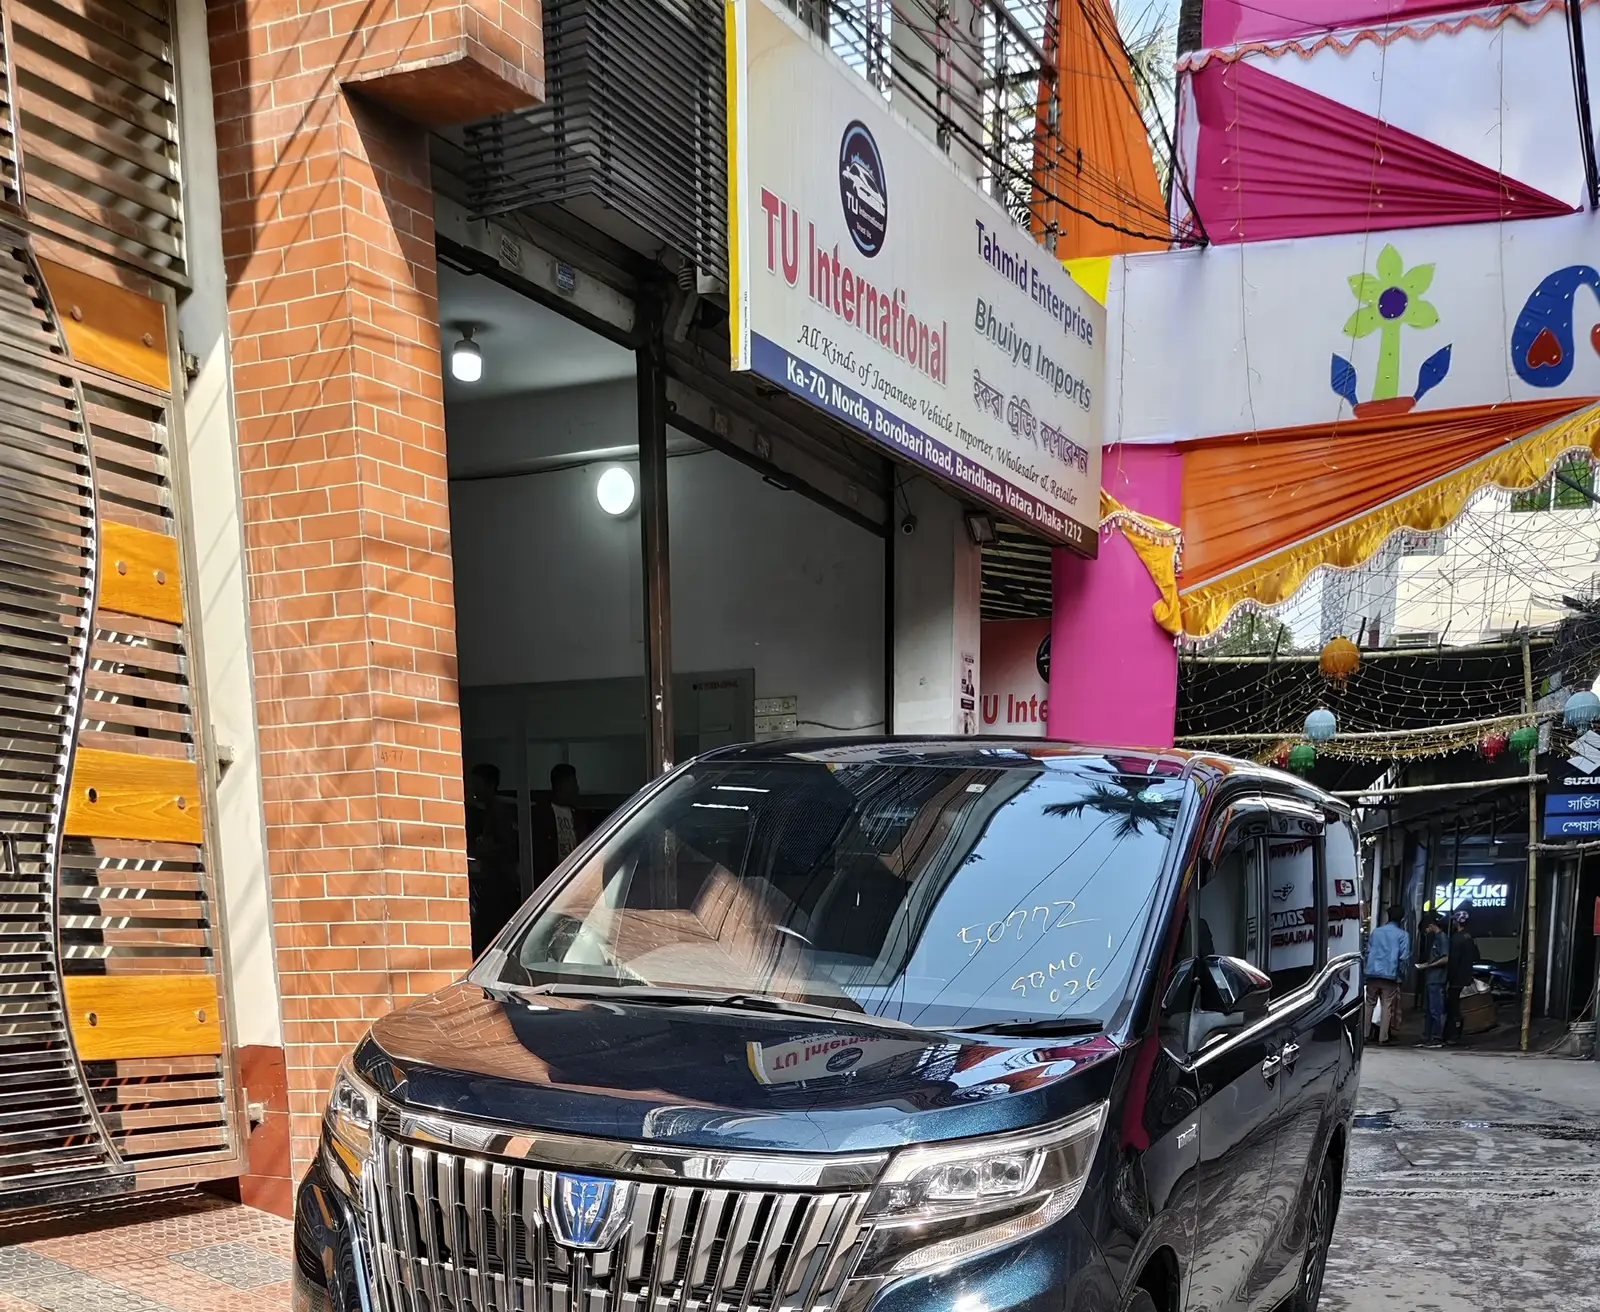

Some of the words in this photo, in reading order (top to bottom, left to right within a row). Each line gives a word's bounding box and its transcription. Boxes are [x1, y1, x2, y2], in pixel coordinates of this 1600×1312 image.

[846, 191, 859, 215] TU
[761, 186, 799, 286] TU
[808, 222, 948, 387] International
[975, 218, 1028, 293] Tahmid
[1031, 267, 1094, 346] Enterprise
[975, 298, 1032, 366] Bhuiya
[1036, 345, 1091, 410] Imports
[786, 356, 829, 404] Ka-70,
[832, 383, 873, 429] Norda,
[875, 409, 924, 456] Borobari
[925, 438, 954, 476] Road,
[956, 458, 1004, 503] Baridhara,
[1004, 483, 1035, 521] Vatara,
[1036, 504, 1083, 543] Dhaka-1212
[797, 325, 822, 350] All
[822, 336, 856, 373] Kinds
[858, 363, 872, 386] of
[871, 370, 917, 411] Japanese
[920, 399, 954, 434] Vehicle
[955, 421, 994, 461] Importer,
[996, 447, 1040, 485] Wholesaler
[1050, 479, 1079, 507] Retailer
[979, 694, 999, 725] U
[1563, 776, 1600, 786] SUZU
[1435, 884, 1508, 898] SUZUKI
[1472, 898, 1506, 907] SERVICE
